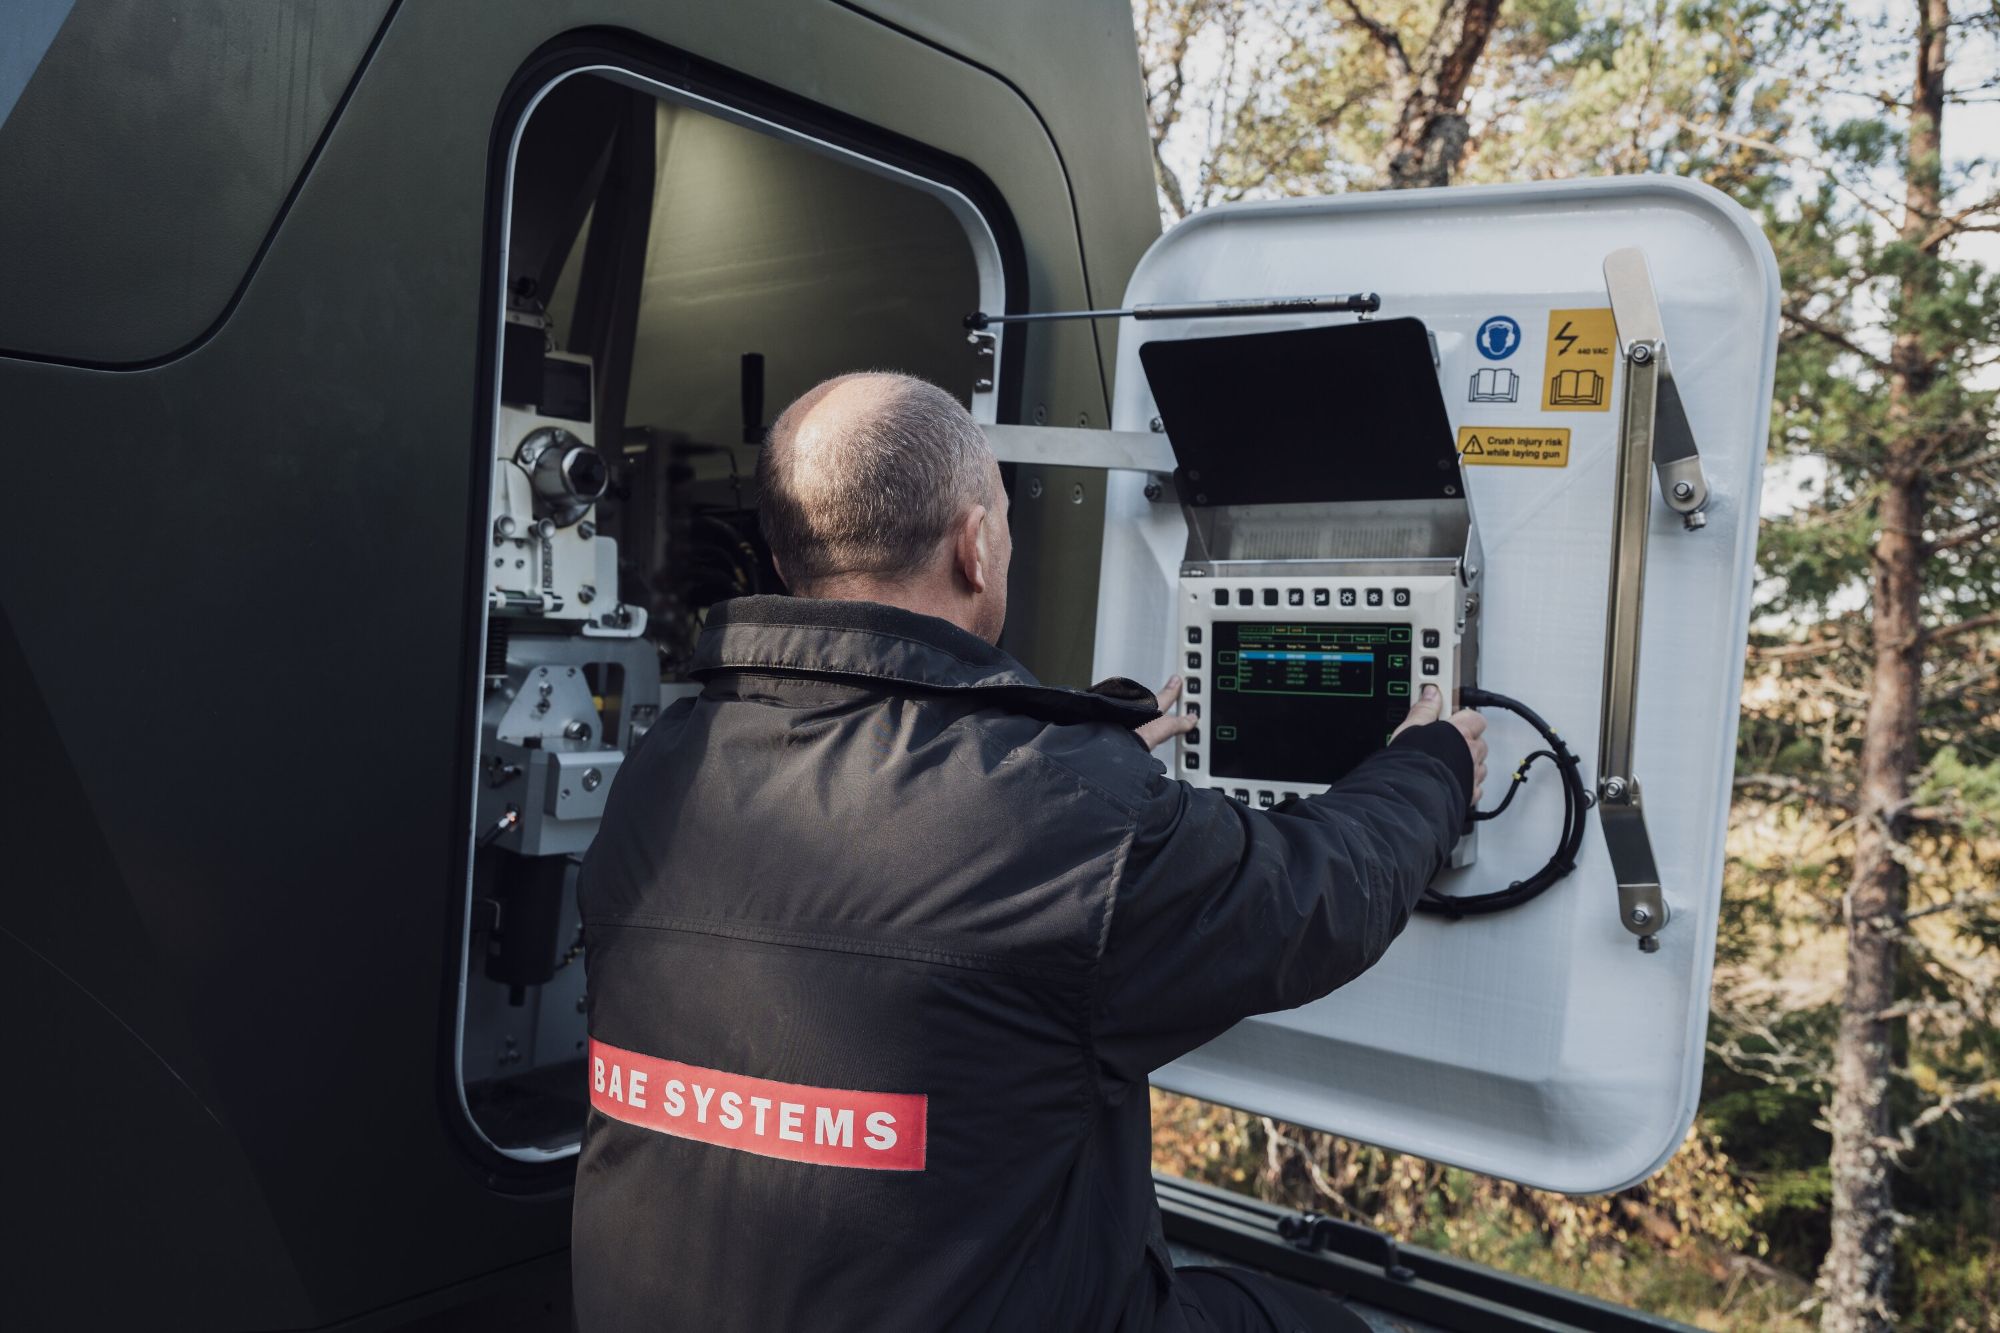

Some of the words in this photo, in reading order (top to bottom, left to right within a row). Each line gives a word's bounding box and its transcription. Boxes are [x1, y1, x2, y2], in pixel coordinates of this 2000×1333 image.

[1592, 347, 1609, 355] VAC
[1487, 436, 1515, 445] Crush
[1517, 437, 1543, 447] injury
[1545, 438, 1562, 446] risk
[1487, 448, 1510, 457] while
[1512, 449, 1540, 460] laying
[1542, 452, 1560, 460] gun
[594, 1056, 648, 1108] BAE
[663, 1079, 898, 1151] SYSTEMS
